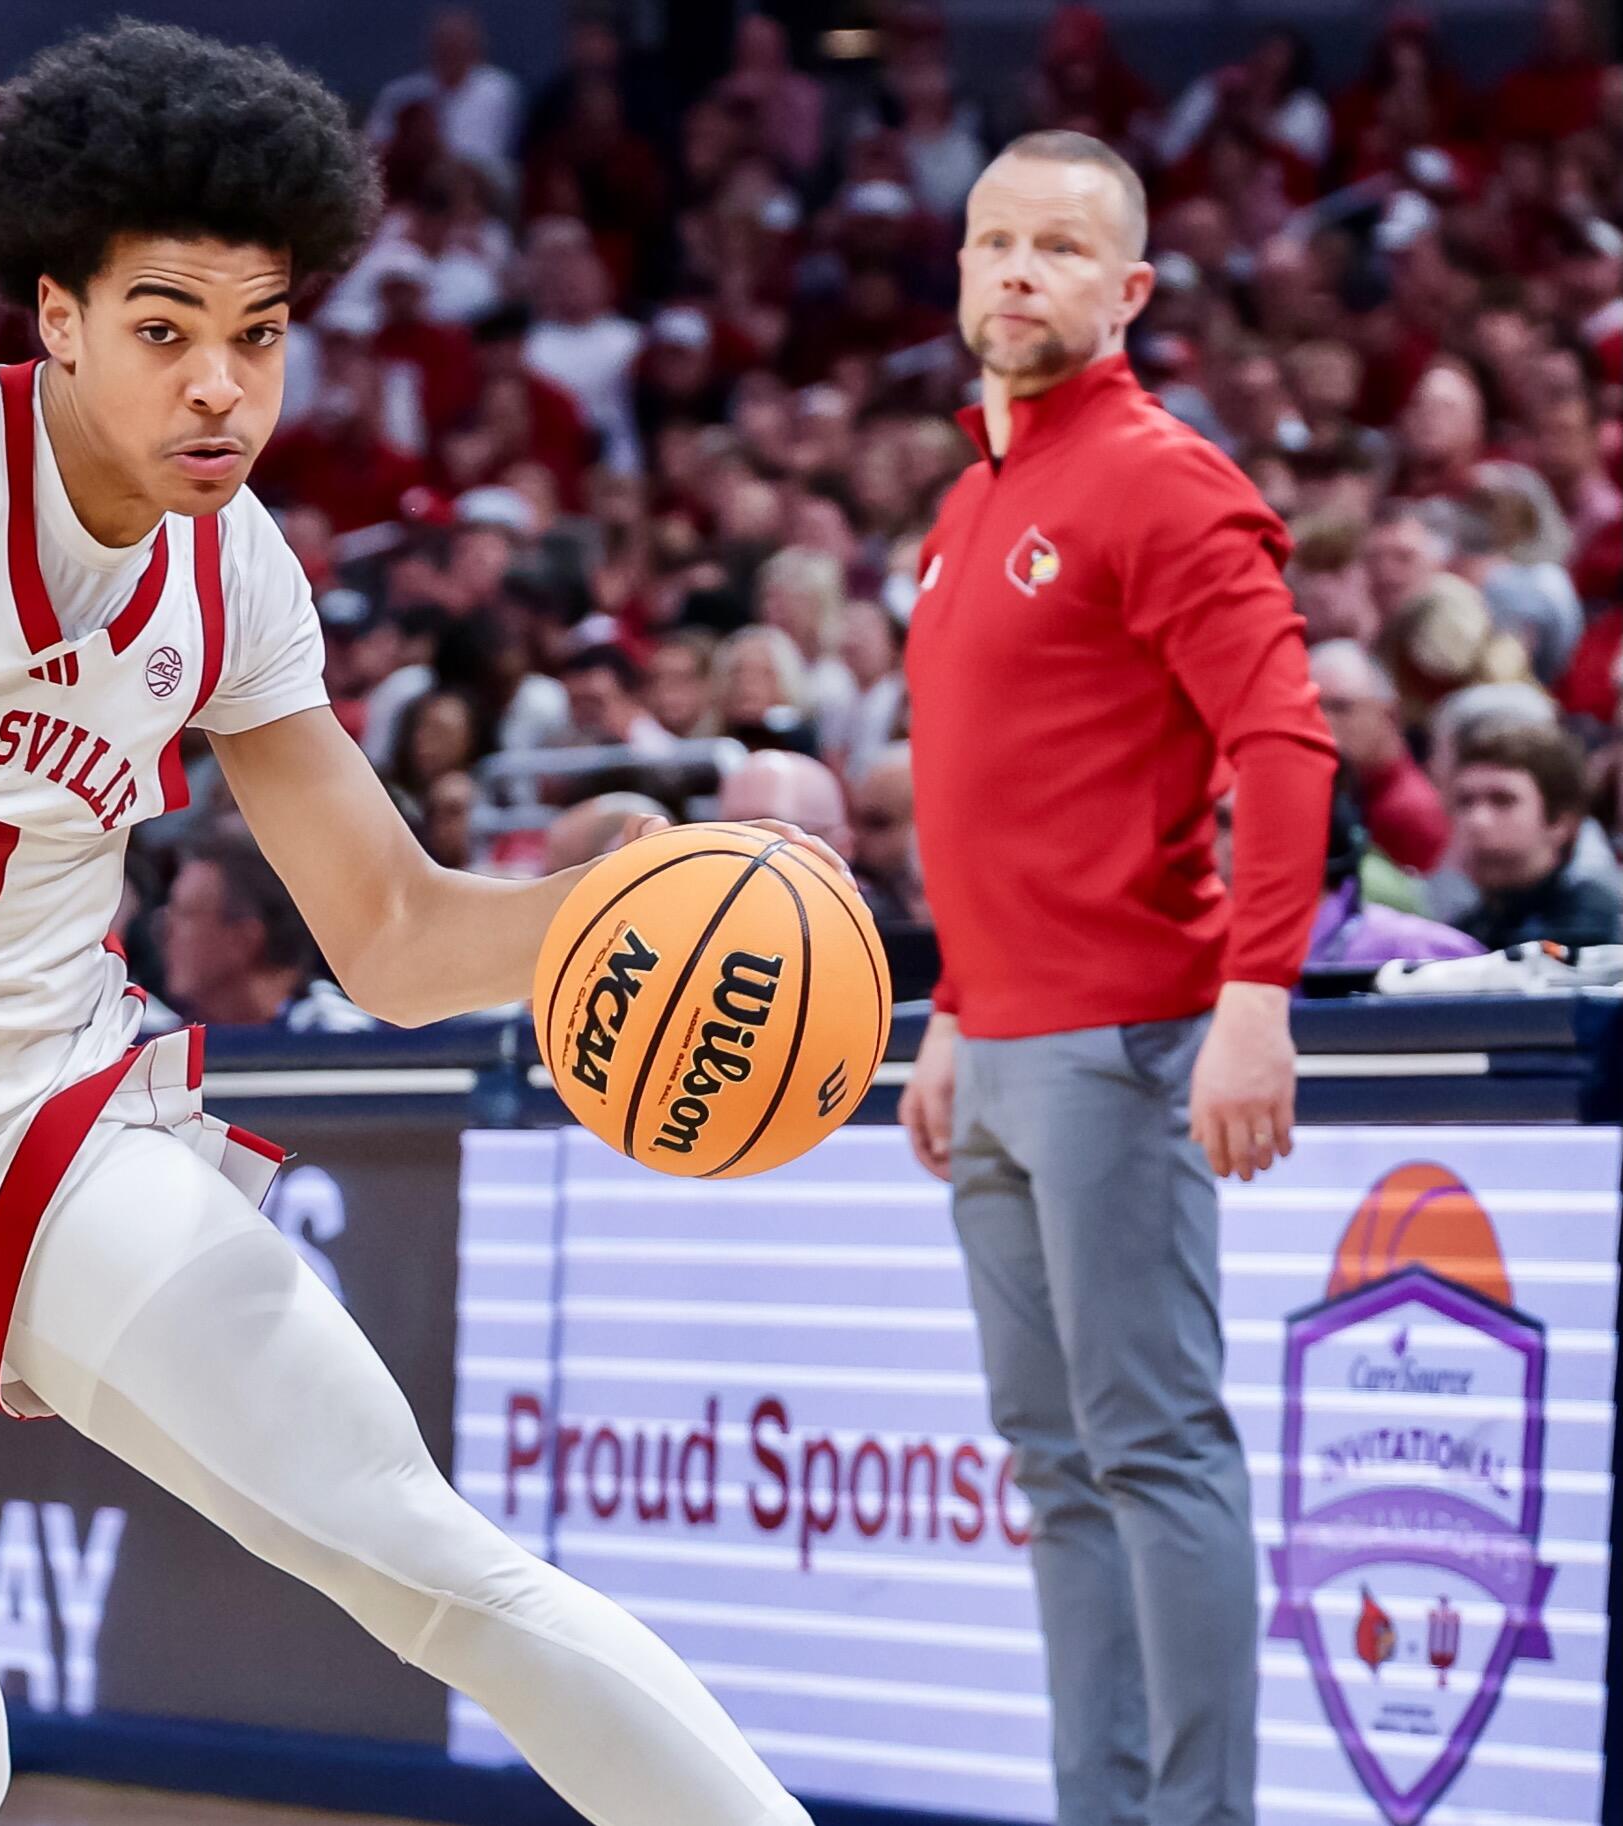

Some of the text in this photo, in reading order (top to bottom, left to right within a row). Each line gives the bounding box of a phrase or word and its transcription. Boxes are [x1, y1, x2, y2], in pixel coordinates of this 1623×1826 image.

[150, 661, 182, 679] ACC
[572, 926, 660, 1095] NCAA
[652, 950, 784, 1154] Wilson
[683, 1007, 701, 1050] INDOOR
[669, 1052, 685, 1082] GAME
[505, 1392, 719, 1525] Proud
